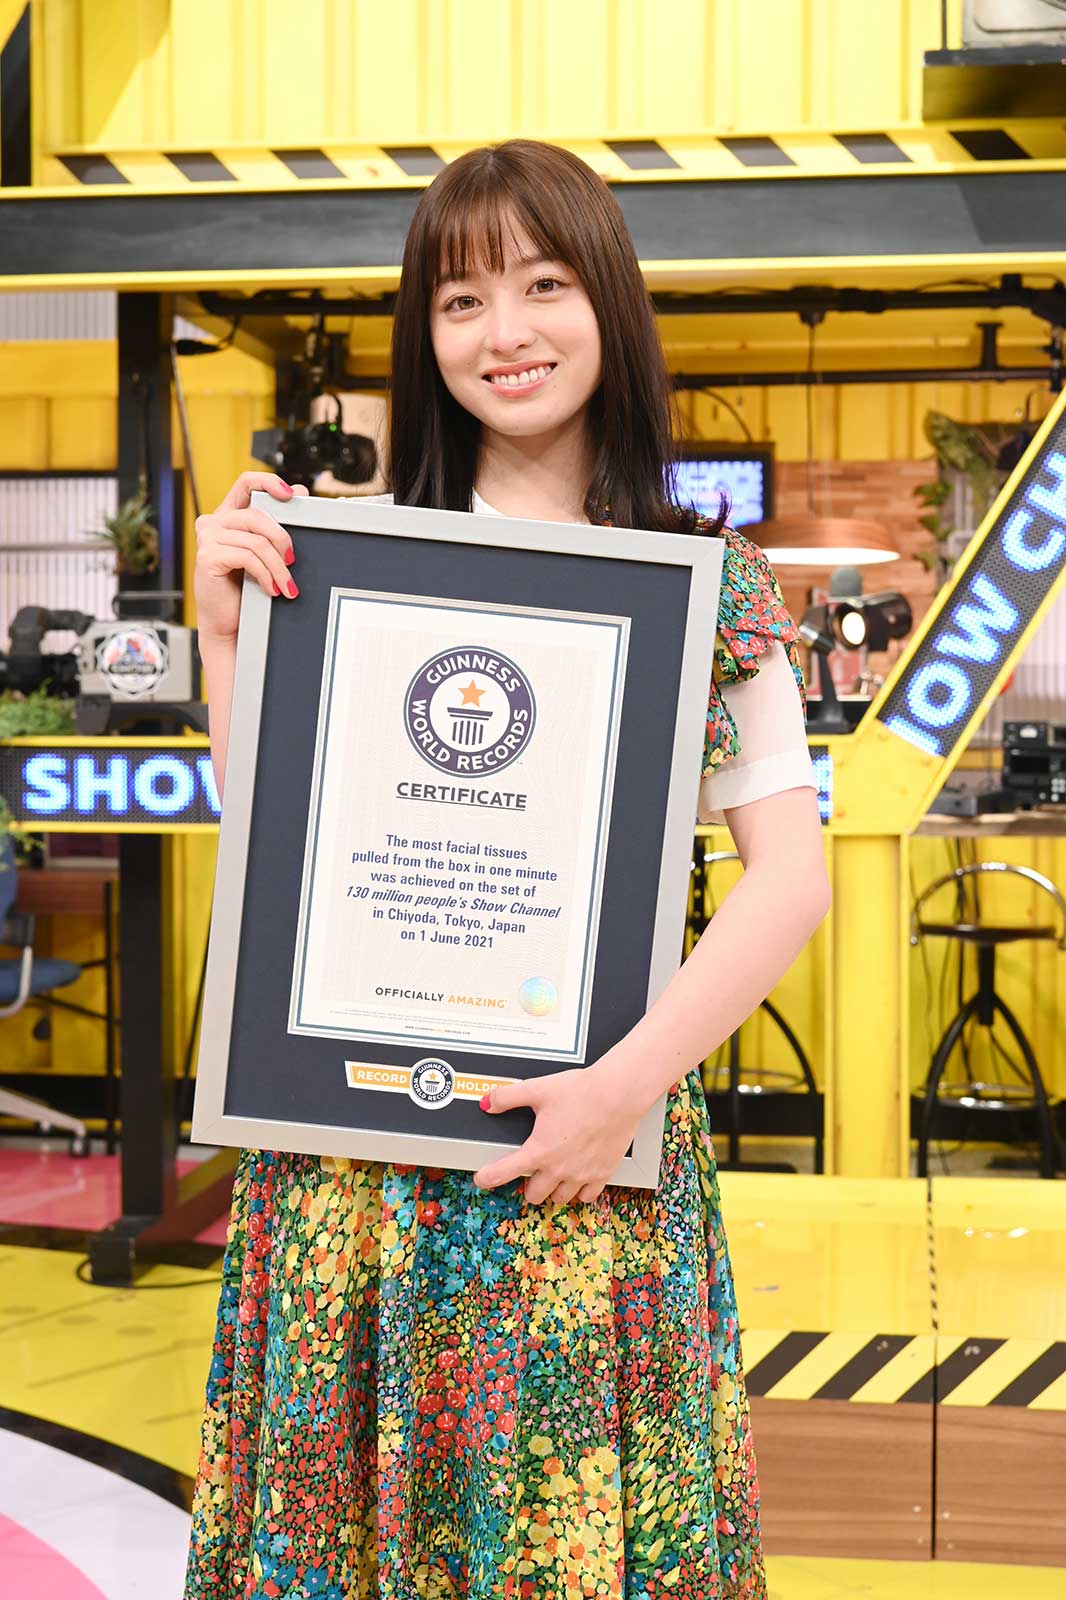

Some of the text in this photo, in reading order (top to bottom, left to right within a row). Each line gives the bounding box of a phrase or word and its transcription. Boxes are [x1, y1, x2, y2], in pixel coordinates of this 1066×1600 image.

[426, 654, 521, 692] GUINNESS
[412, 699, 528, 770] WORLD RECORDS
[396, 782, 527, 809] CERTIFICATE
[386, 834, 528, 860] The most facial tissues
[352, 851, 558, 881] pulled from the box in one minute
[370, 872, 536, 897] was achieved on the set of
[347, 886, 561, 918] 130 million people's Show Channel
[373, 907, 526, 934] in Chiyoda, Tokyo, Japan
[401, 930, 493, 948] on 1 June 2021
[375, 987, 505, 1008] OFFICIALLY AMAZING
[357, 1070, 407, 1084] RECORD
[418, 1063, 448, 1076] GUINNESS
[414, 1078, 451, 1101] WORLD RECORDS
[457, 1080, 498, 1092] HOLDE
